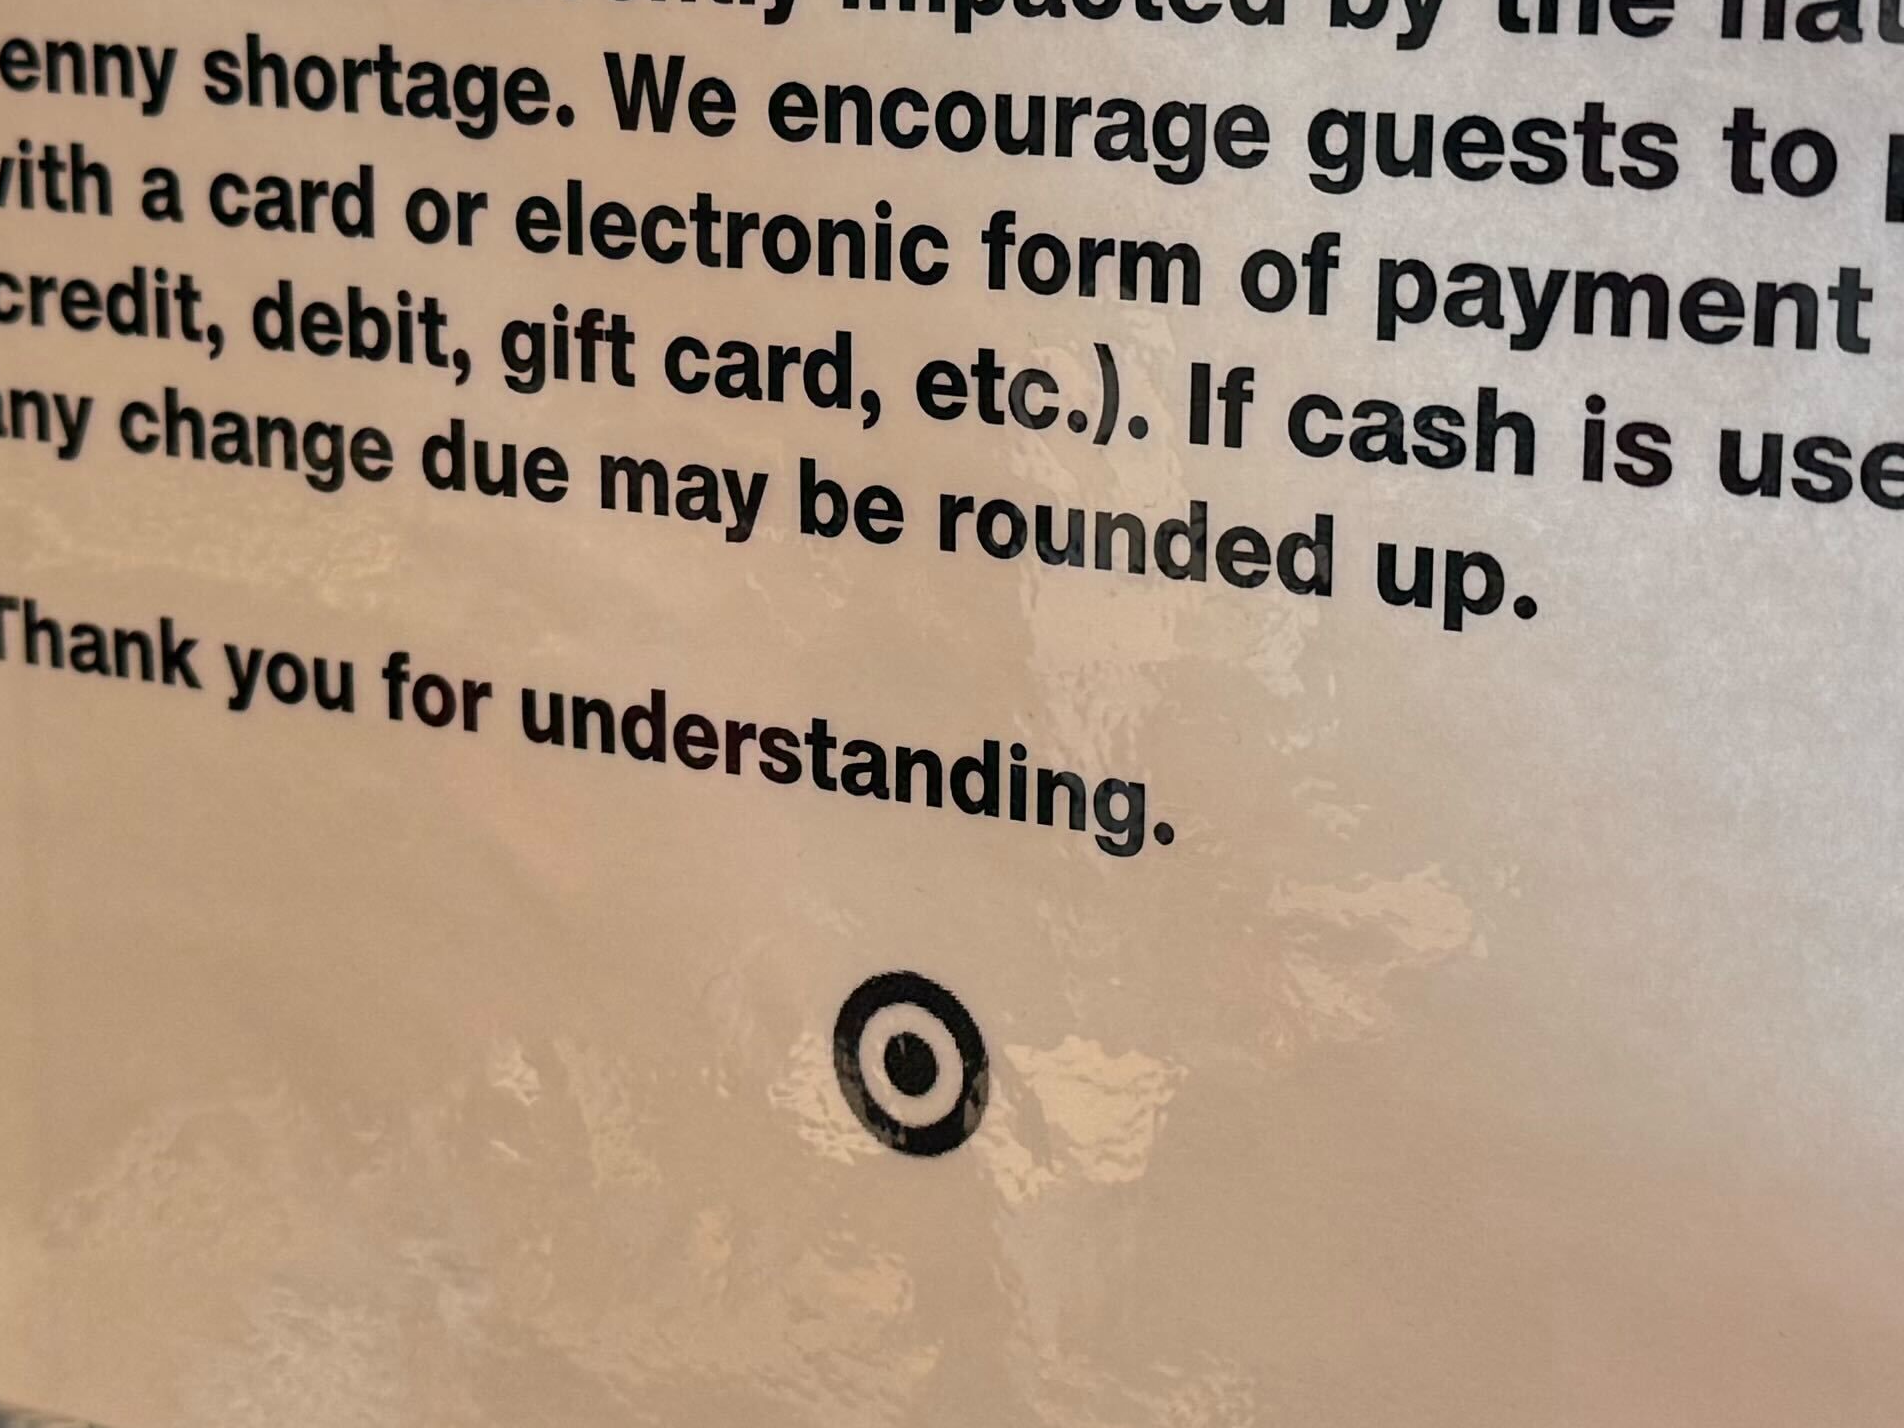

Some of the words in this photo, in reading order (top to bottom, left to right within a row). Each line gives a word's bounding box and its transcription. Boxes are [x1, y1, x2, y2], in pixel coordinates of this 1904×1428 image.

[202, 31, 576, 142] shortage.
[602, 50, 738, 139] We
[766, 79, 1272, 187] encourage
[1306, 100, 1681, 196] guests
[1721, 105, 1839, 200] to
[140, 165, 185, 224] a
[207, 162, 376, 240] card
[404, 186, 490, 248] or
[514, 177, 951, 287] electronic
[979, 208, 1202, 308] form
[1239, 230, 1342, 317] of
[1375, 256, 1875, 356] payment
[251, 277, 473, 388] debit,
[499, 301, 637, 396] gift
[663, 328, 883, 431] card,
[914, 341, 1150, 447] etc.).
[1188, 360, 1256, 450] If
[1286, 385, 1537, 478] cash
[1581, 392, 1674, 490] is
[117, 385, 395, 495] change
[420, 416, 570, 505] due
[598, 453, 770, 545] may
[798, 455, 906, 546] be
[938, 492, 1335, 599] rounded
[1375, 541, 1539, 634] up.
[222, 642, 356, 715] you
[380, 650, 494, 734] for
[520, 686, 1176, 859] understanding.
